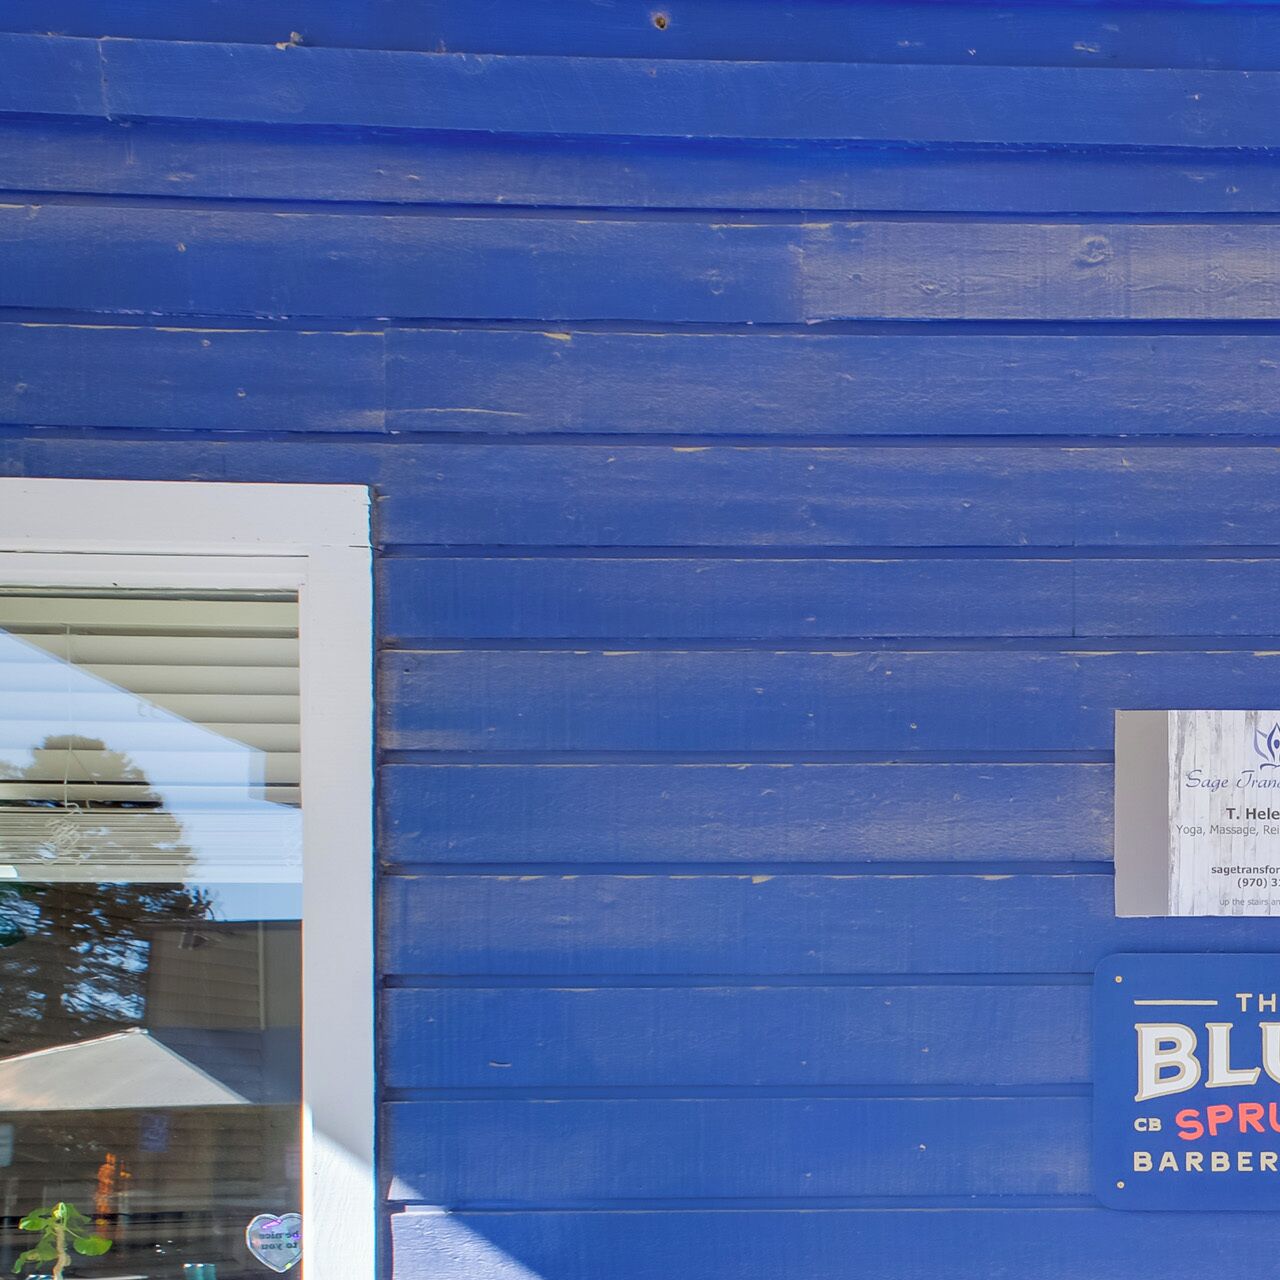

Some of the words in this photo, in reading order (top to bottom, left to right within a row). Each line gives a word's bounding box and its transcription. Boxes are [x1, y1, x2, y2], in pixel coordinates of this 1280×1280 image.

[1185, 769, 1229, 792] Sage
[1225, 807, 1240, 820] T.
[1176, 824, 1206, 837] Yoga,
[1209, 824, 1259, 837] Massage,
[1237, 877, 1268, 889] (970)
[1220, 899, 1230, 907] up
[1232, 898, 1245, 906] the
[1247, 898, 1269, 906] stairs
[1133, 1117, 1162, 1132] CB
[1133, 1151, 1279, 1172] BARBER
